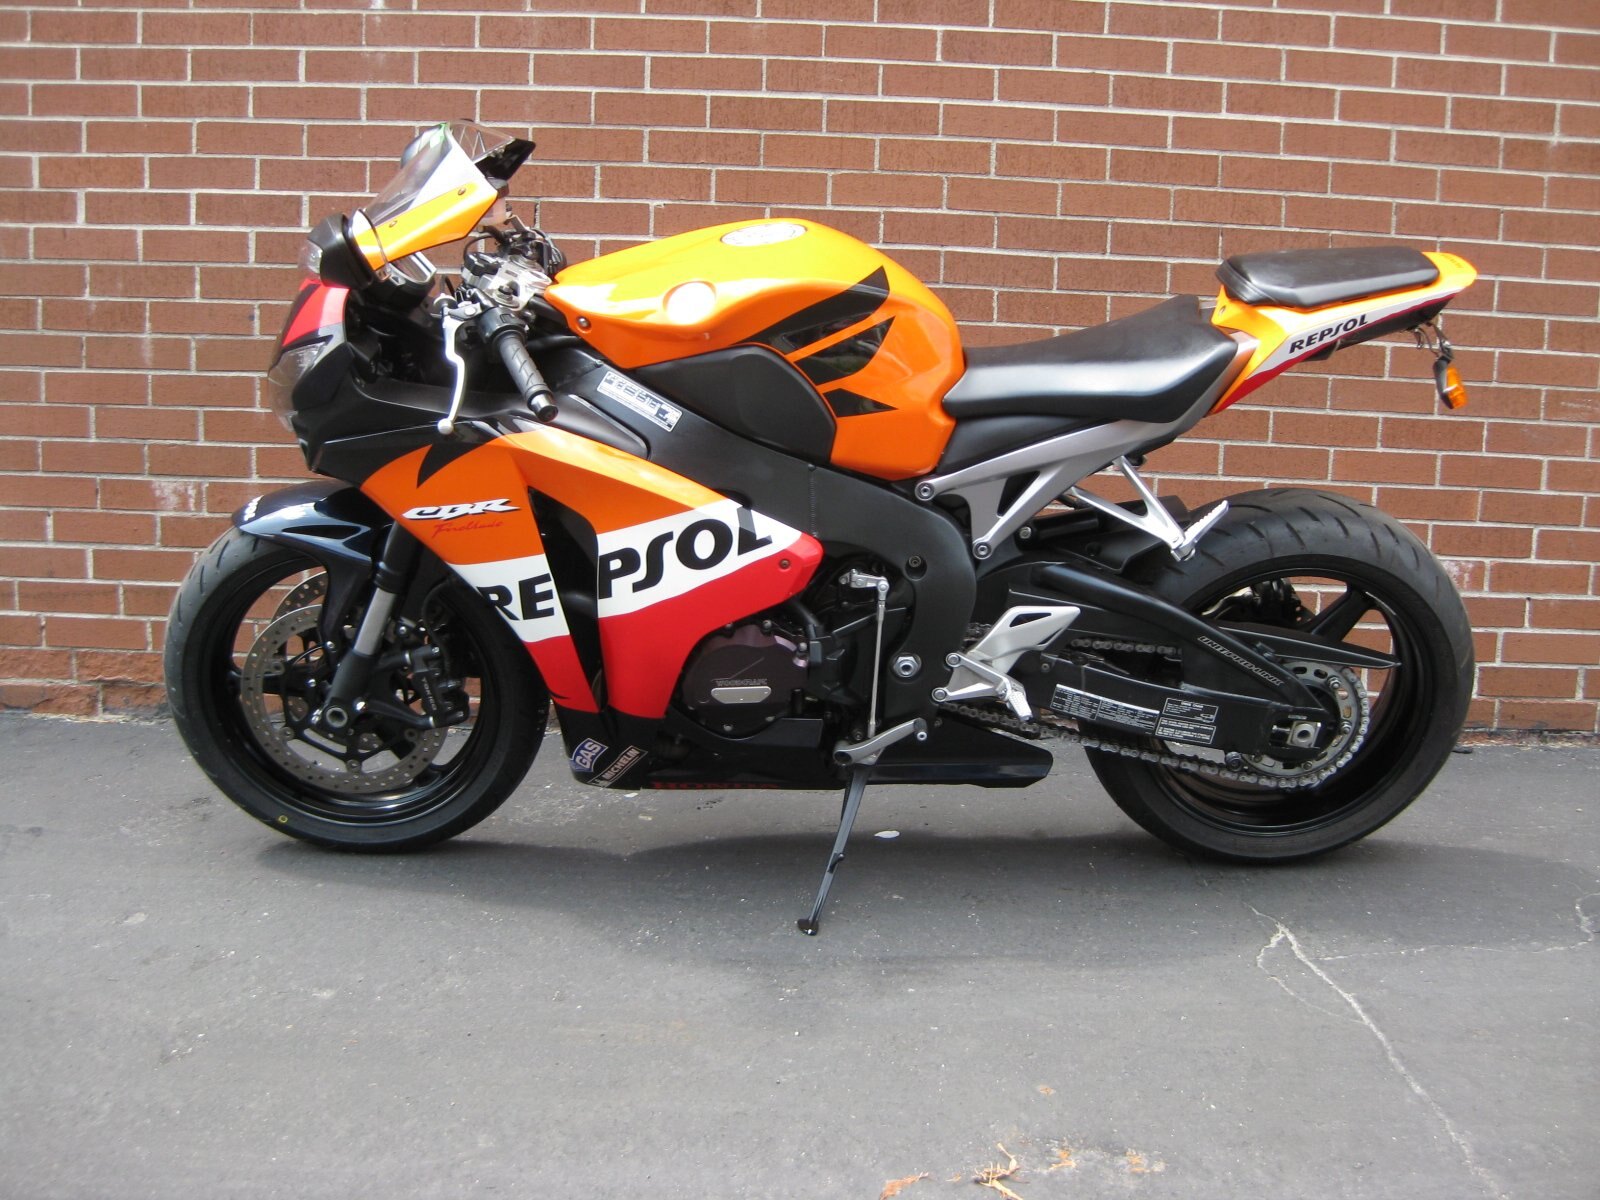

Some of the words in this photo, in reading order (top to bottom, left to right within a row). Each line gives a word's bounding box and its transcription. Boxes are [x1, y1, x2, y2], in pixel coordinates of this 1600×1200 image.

[1289, 314, 1368, 354] REPSOL
[402, 498, 521, 521] CBR
[575, 742, 602, 769] GAS
[602, 748, 640, 779] MICHELIN
